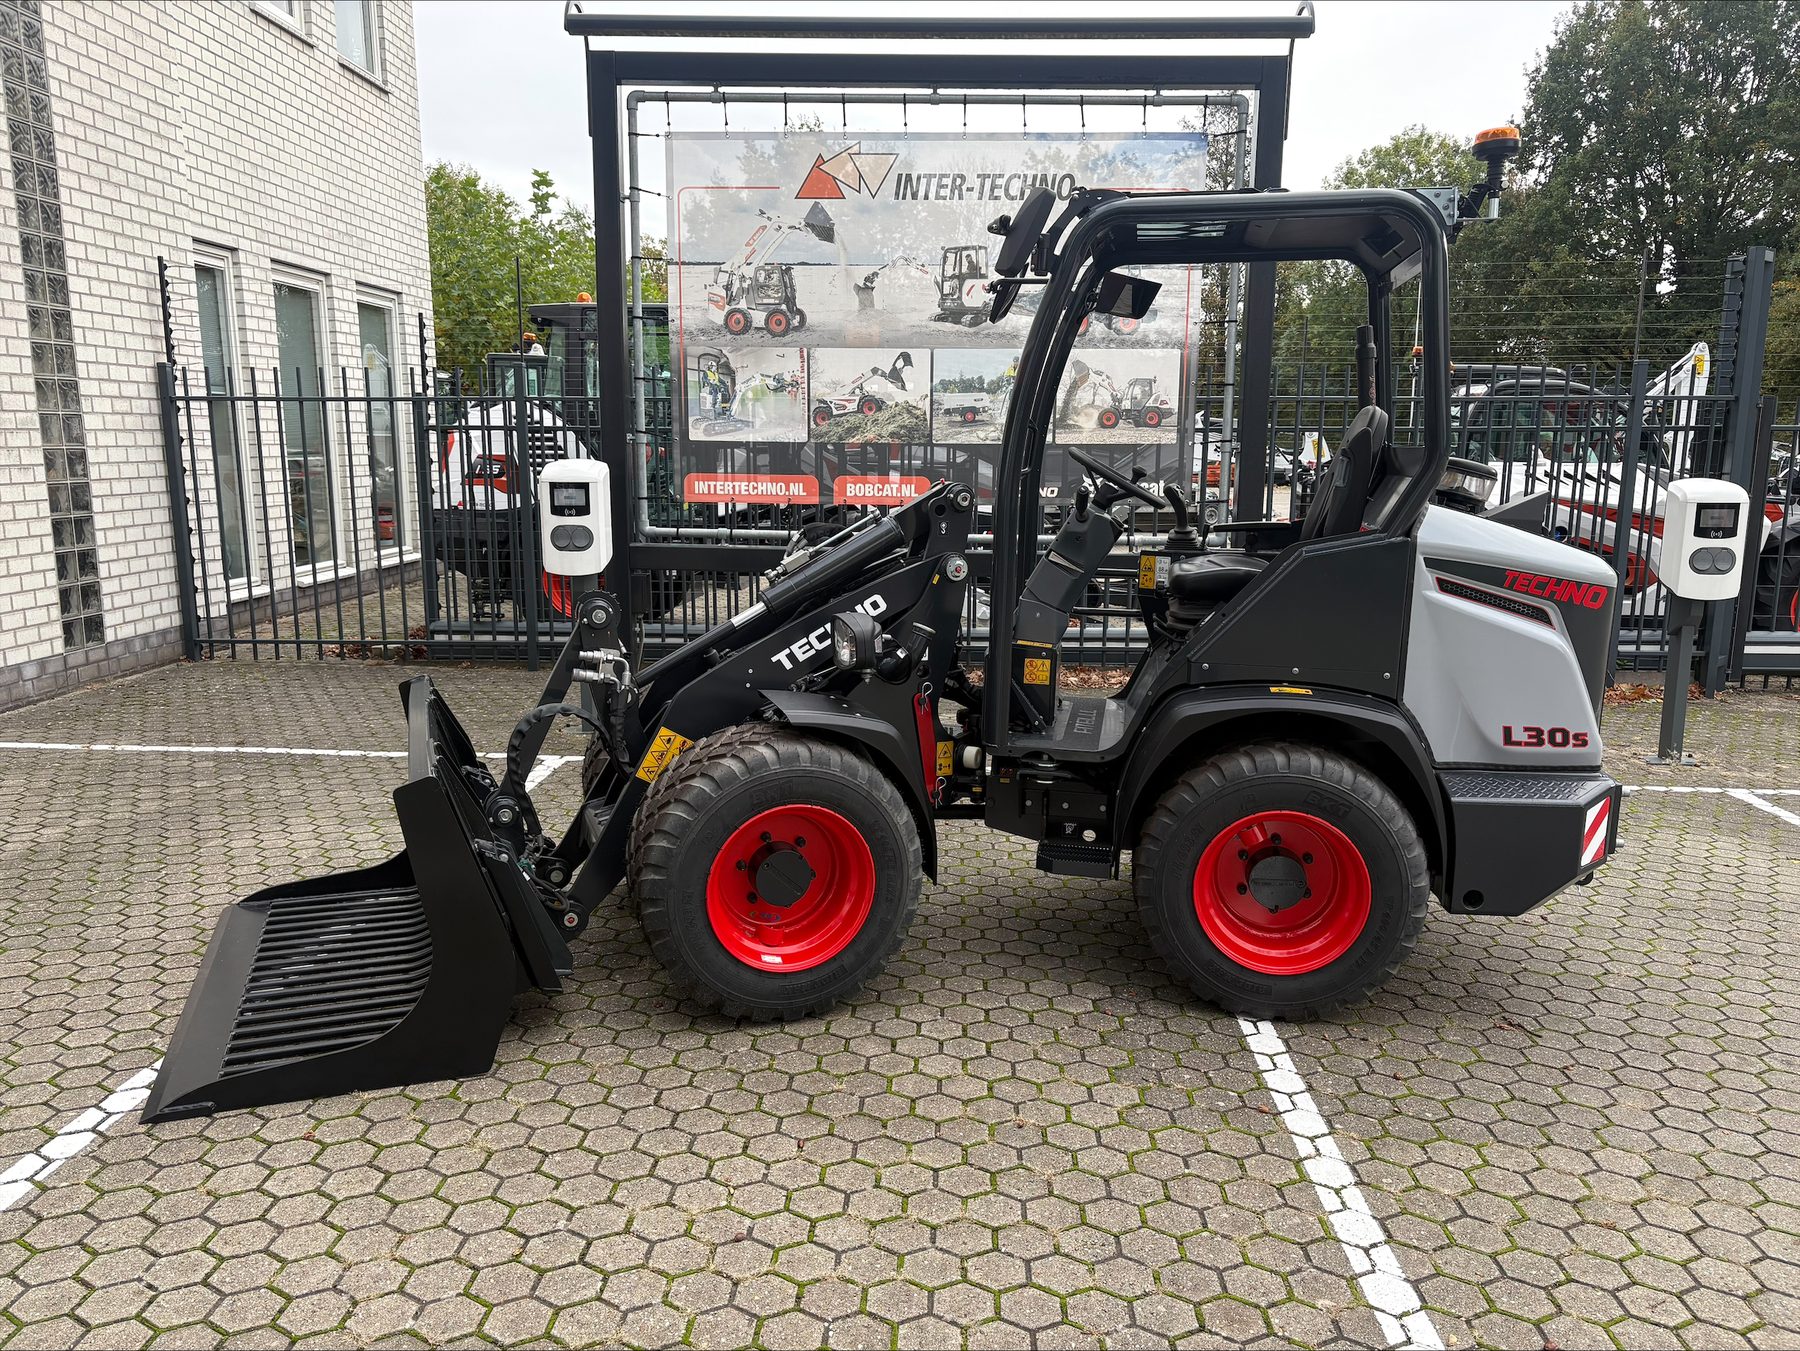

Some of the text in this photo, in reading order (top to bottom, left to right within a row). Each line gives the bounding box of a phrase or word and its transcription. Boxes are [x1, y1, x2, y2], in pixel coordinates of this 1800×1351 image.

[694, 480, 807, 496] INTERTECHNO.NL
[846, 483, 919, 498] BOBCAT.NL
[1503, 569, 1609, 610] TECHNO
[770, 594, 888, 671] TECO
[1502, 725, 1589, 748] L30s
